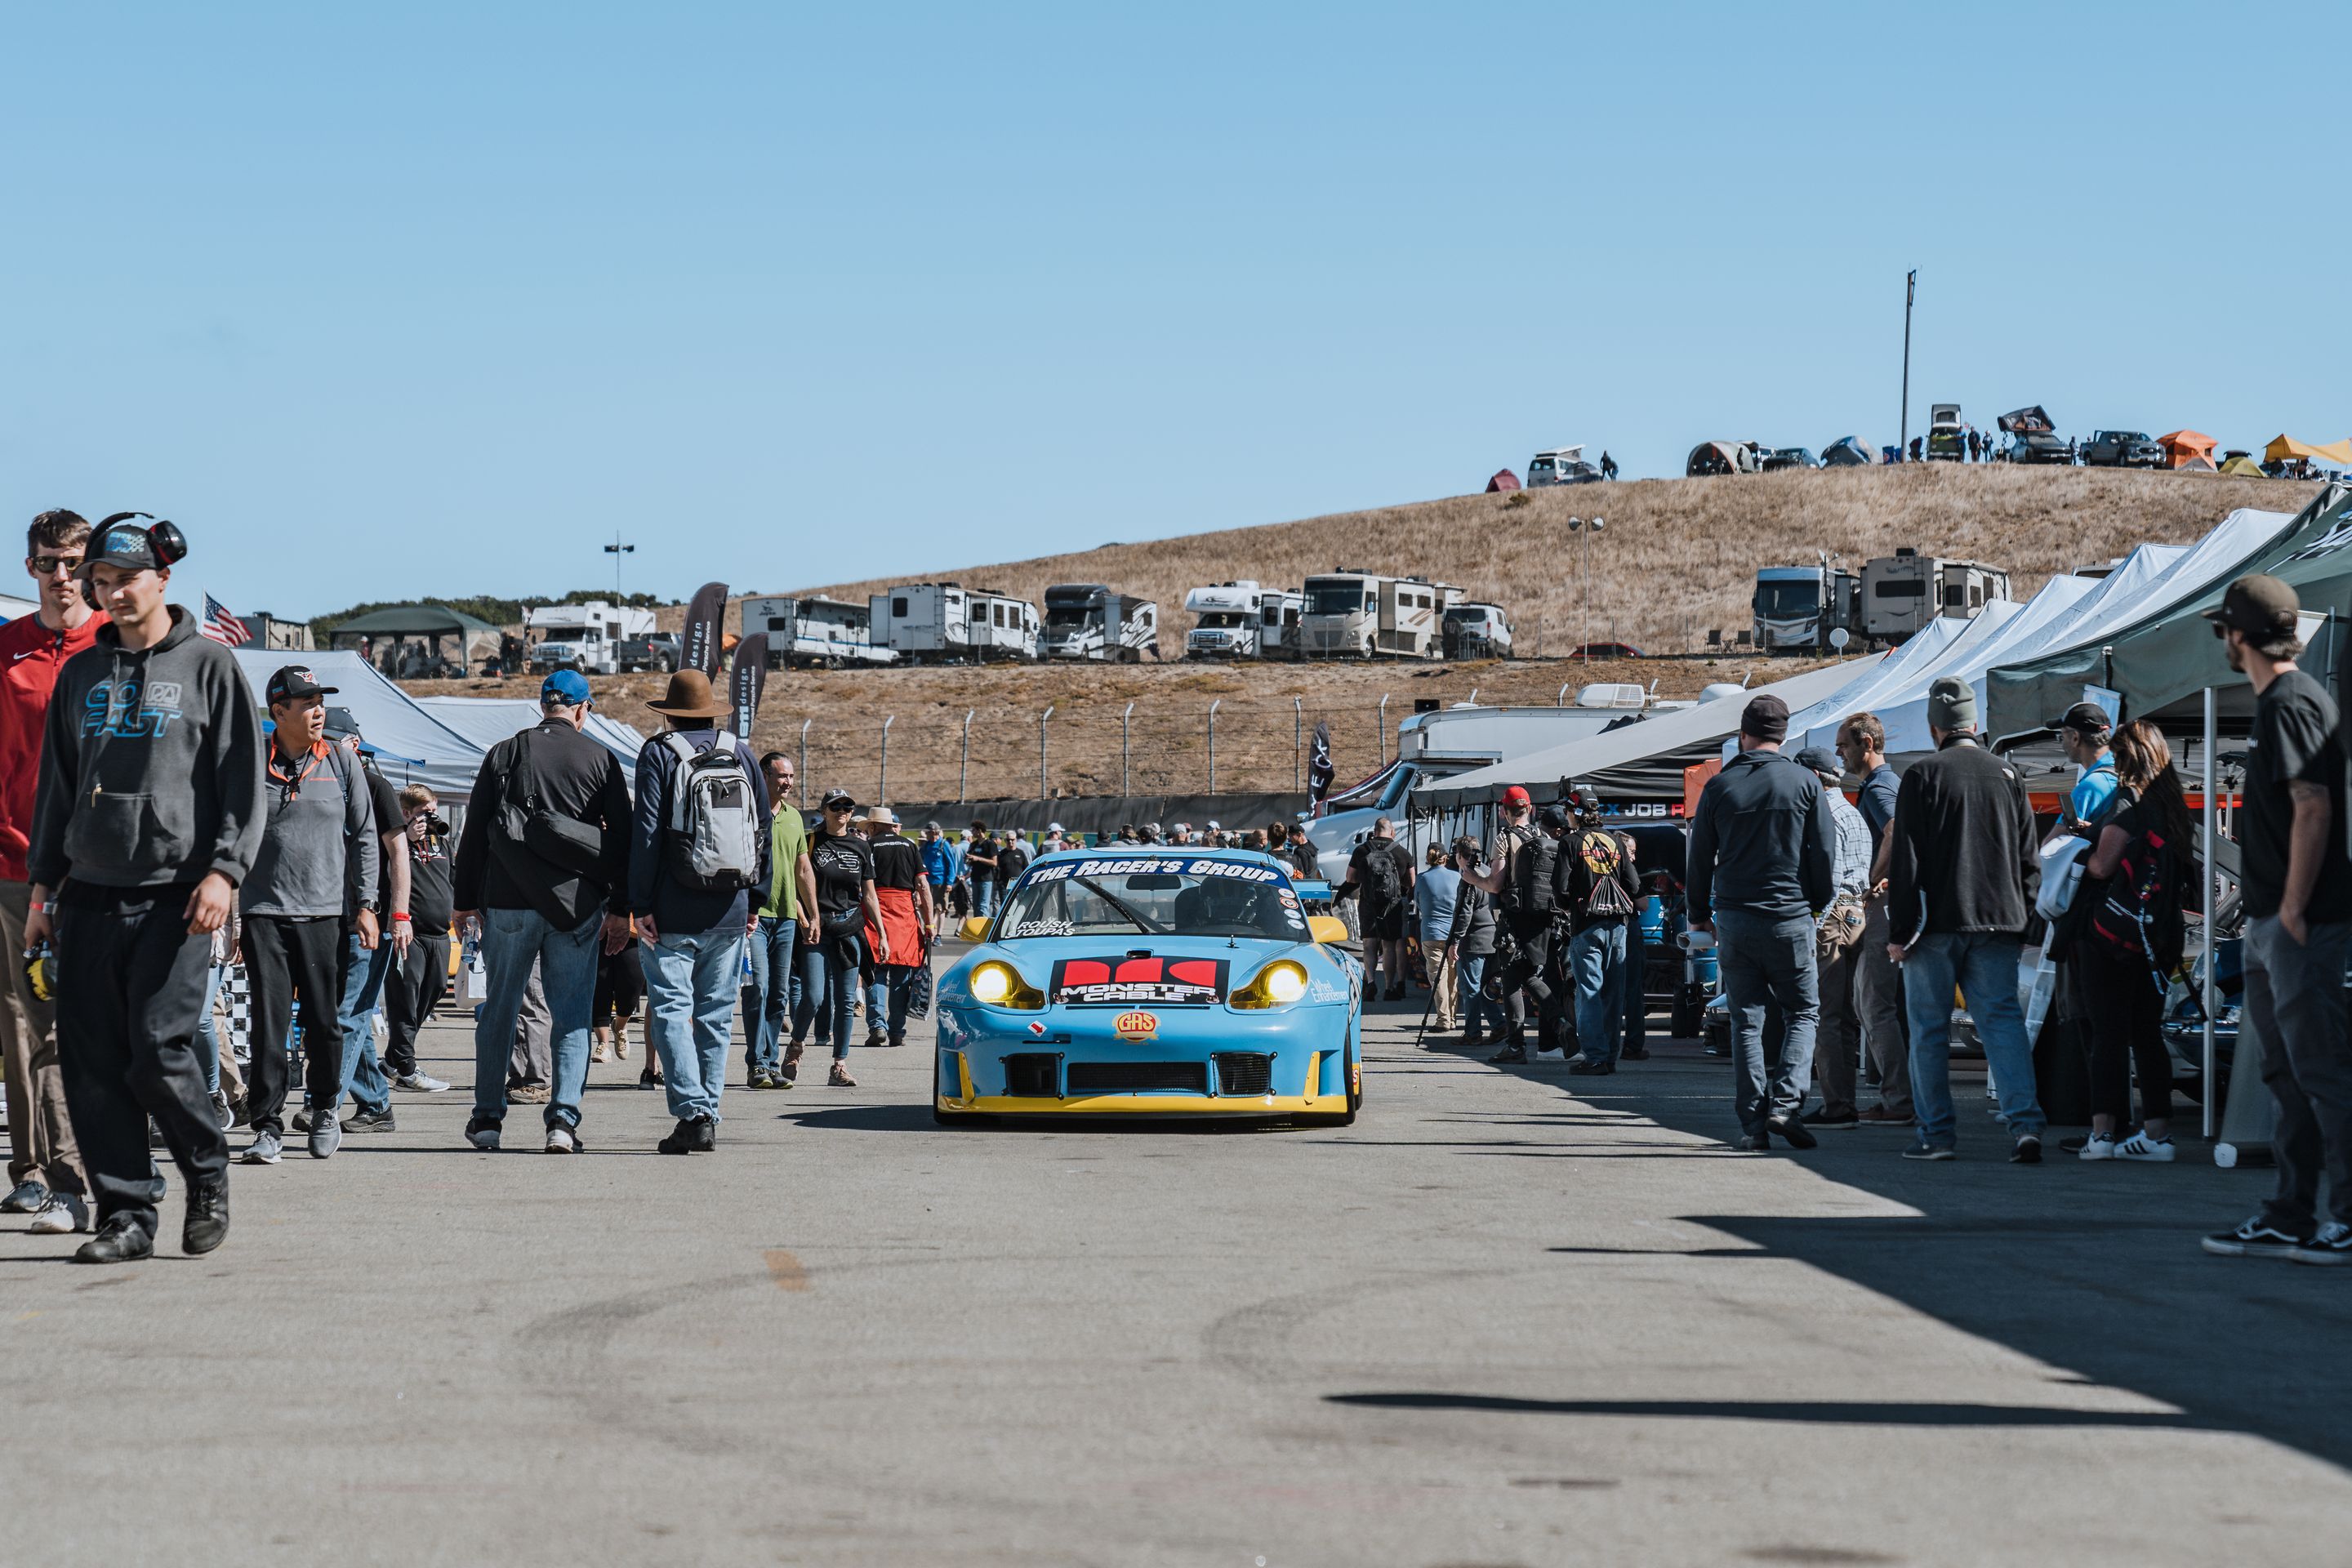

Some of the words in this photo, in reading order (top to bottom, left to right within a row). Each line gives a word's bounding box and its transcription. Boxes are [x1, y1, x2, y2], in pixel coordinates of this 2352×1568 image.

[689, 621, 702, 666] design
[702, 646, 710, 671] Porsche
[740, 668, 749, 704] design
[1625, 804, 1666, 817] JOB
[1028, 864, 1075, 885] THE
[1074, 860, 1184, 876] RACER'S
[1187, 860, 1279, 883] GROUP
[1018, 920, 1074, 930] ROUSH
[1060, 983, 1216, 996] MONSTER
[1312, 979, 1334, 993] Wheel
[1083, 991, 1186, 1002] CABLE
[1310, 988, 1348, 1003] Enhancemen
[1118, 1013, 1155, 1031] GAS
